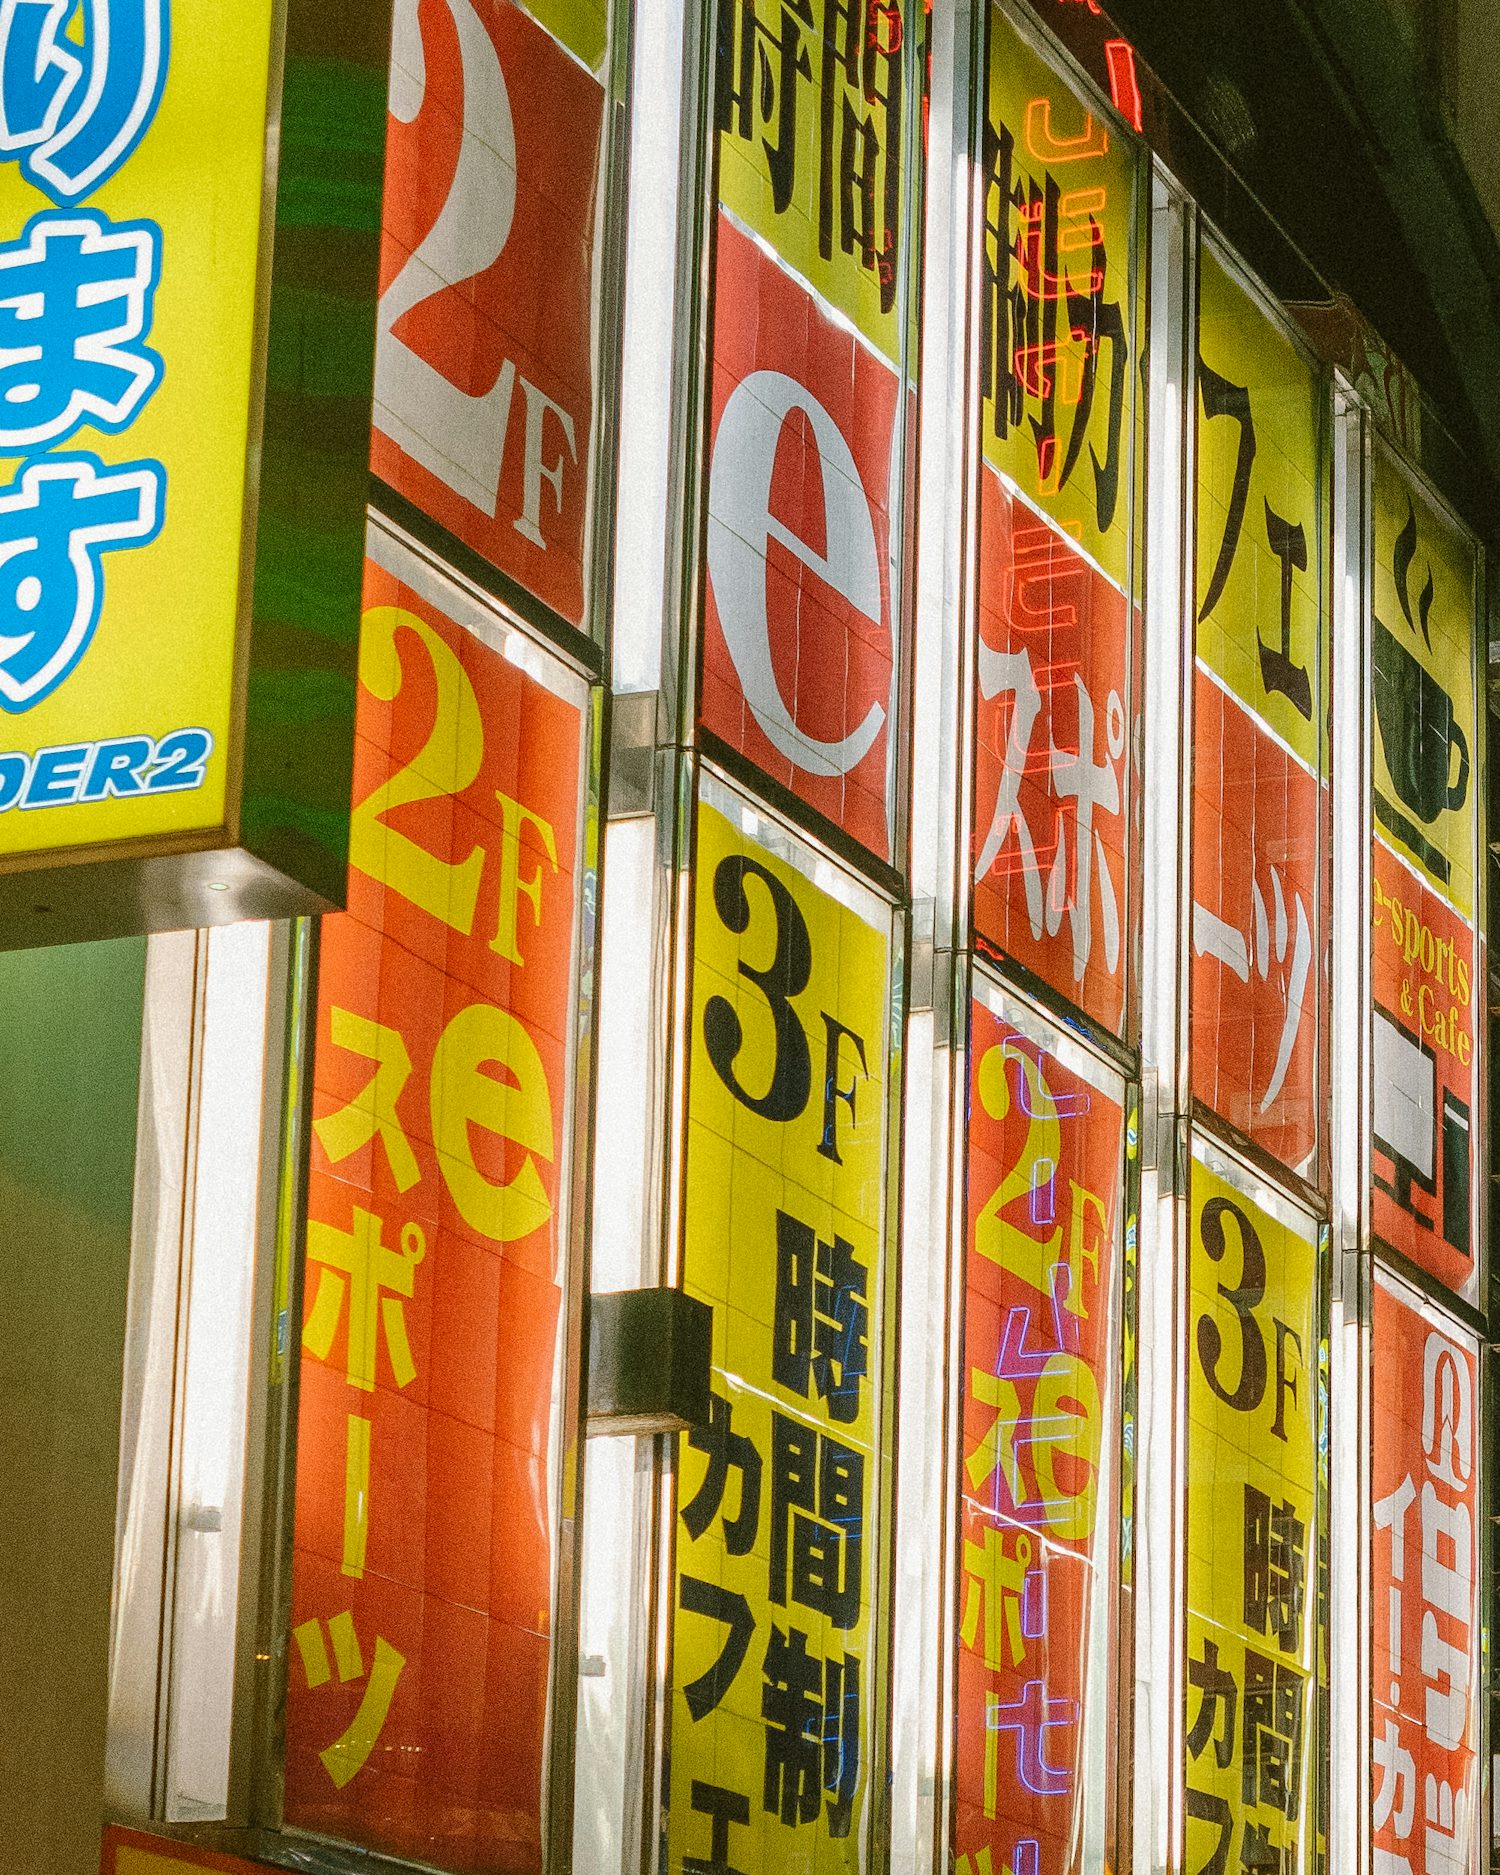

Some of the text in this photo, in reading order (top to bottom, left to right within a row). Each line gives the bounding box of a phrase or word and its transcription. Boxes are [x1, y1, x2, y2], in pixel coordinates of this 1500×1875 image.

[349, 605, 558, 965] 2F
[703, 854, 868, 1165] 3F
[1418, 984, 1471, 1067] Cafe
[975, 1044, 1111, 1320] 2F
[1197, 1196, 1303, 1442] 3F
[293, 1003, 554, 1790] e スポーツ
[763, 1208, 868, 1838] 時間制
